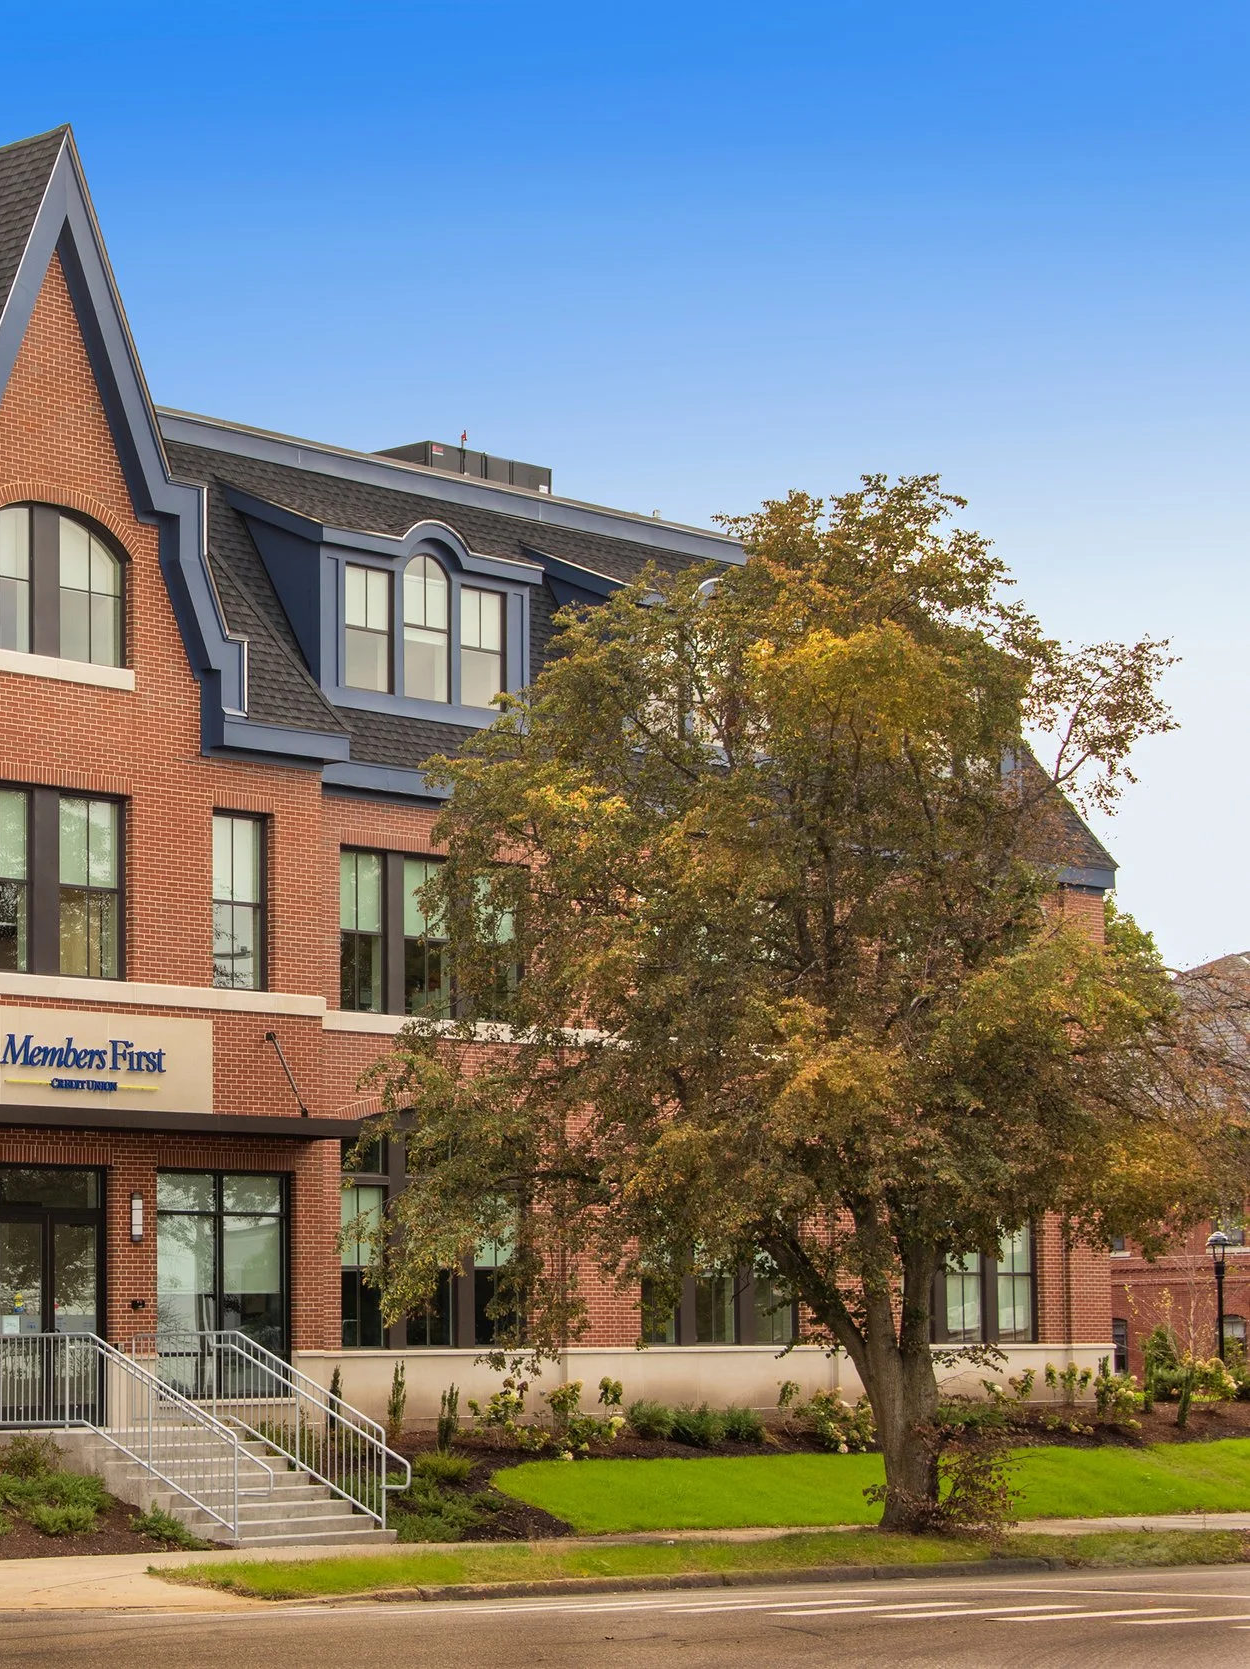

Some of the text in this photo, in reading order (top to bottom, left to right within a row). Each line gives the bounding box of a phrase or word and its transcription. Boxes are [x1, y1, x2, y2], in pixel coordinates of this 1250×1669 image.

[0, 1034, 167, 1073] Members First
[51, 1078, 118, 1092] CREDIT UNION
